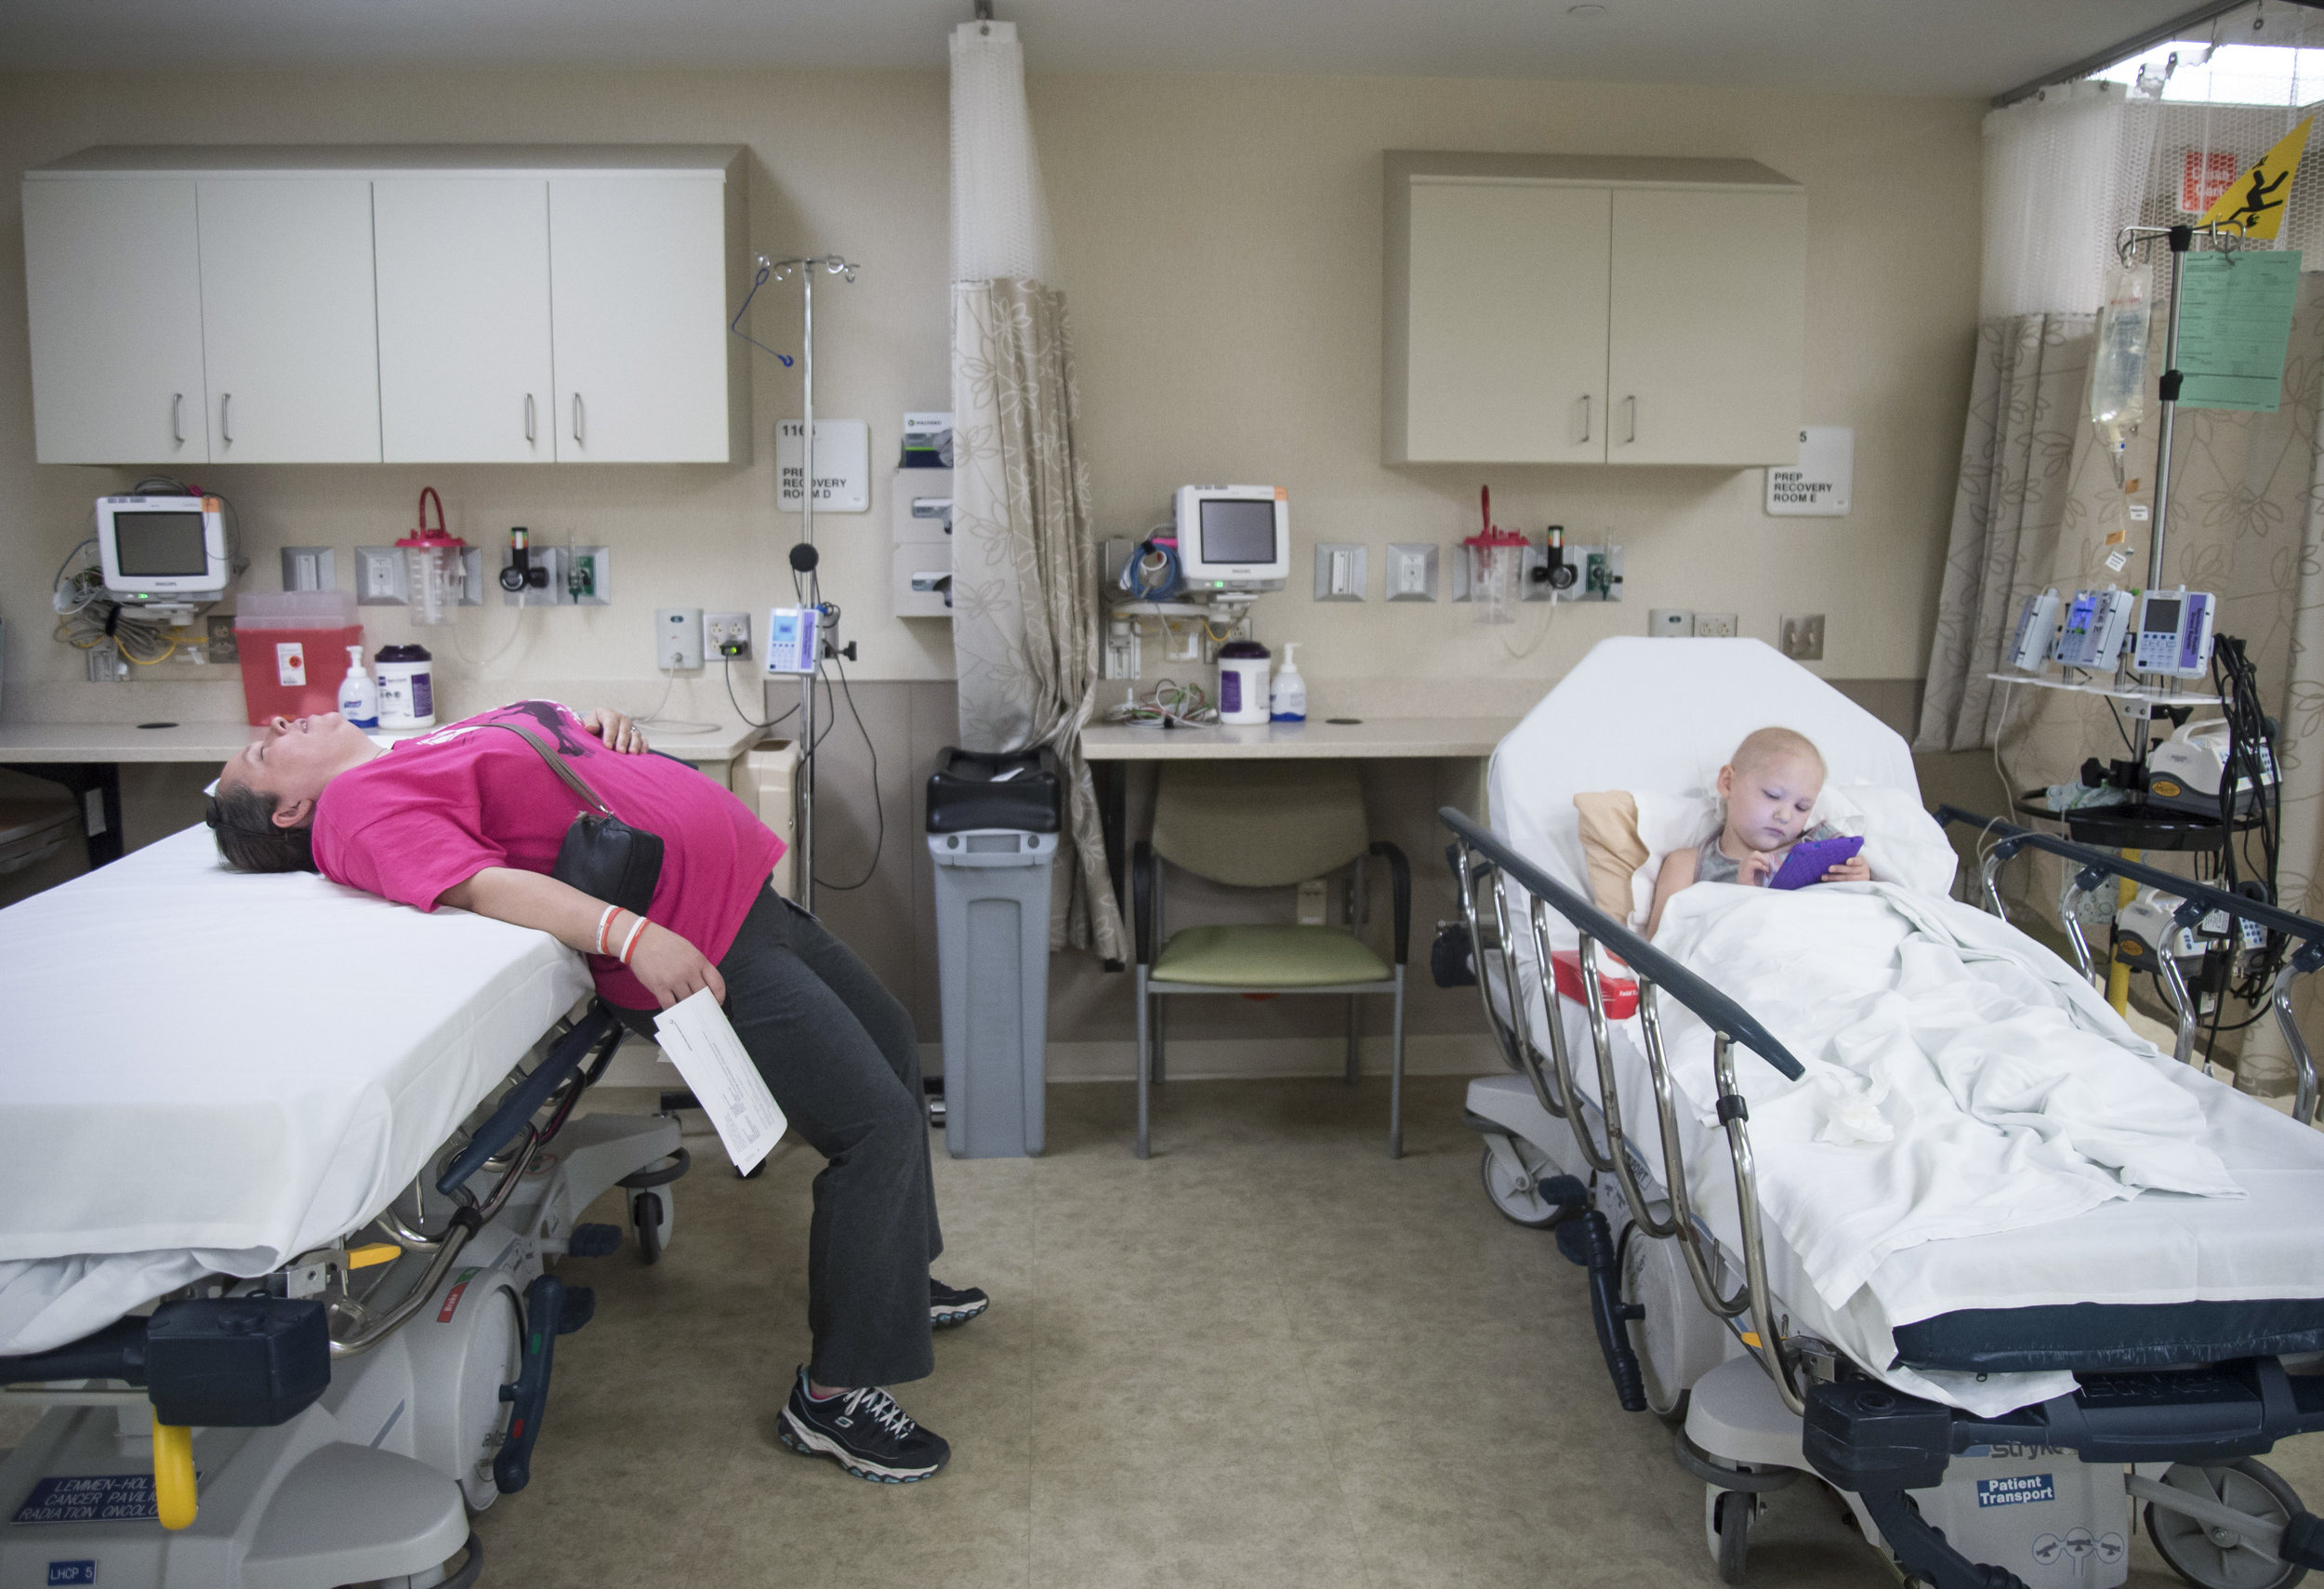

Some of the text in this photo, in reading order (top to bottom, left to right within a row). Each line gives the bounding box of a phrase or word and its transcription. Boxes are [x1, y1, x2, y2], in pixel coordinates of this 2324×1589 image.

[2193, 168, 2230, 181] Cash
[783, 468, 804, 477] PRE
[1774, 472, 1802, 482] PREP
[824, 490, 832, 499] D
[1774, 483, 1832, 492] RECOVERY
[1774, 494, 1817, 503] ROOM E
[54, 1477, 156, 1492] LEMMEN-HOL
[1988, 1476, 2041, 1492] Patient
[44, 1490, 157, 1505] CANCER PAVILI
[1979, 1487, 2053, 1504] Transport
[18, 1503, 159, 1520] RADIATION ONCOLO
[50, 1566, 93, 1581] LHCP 5
